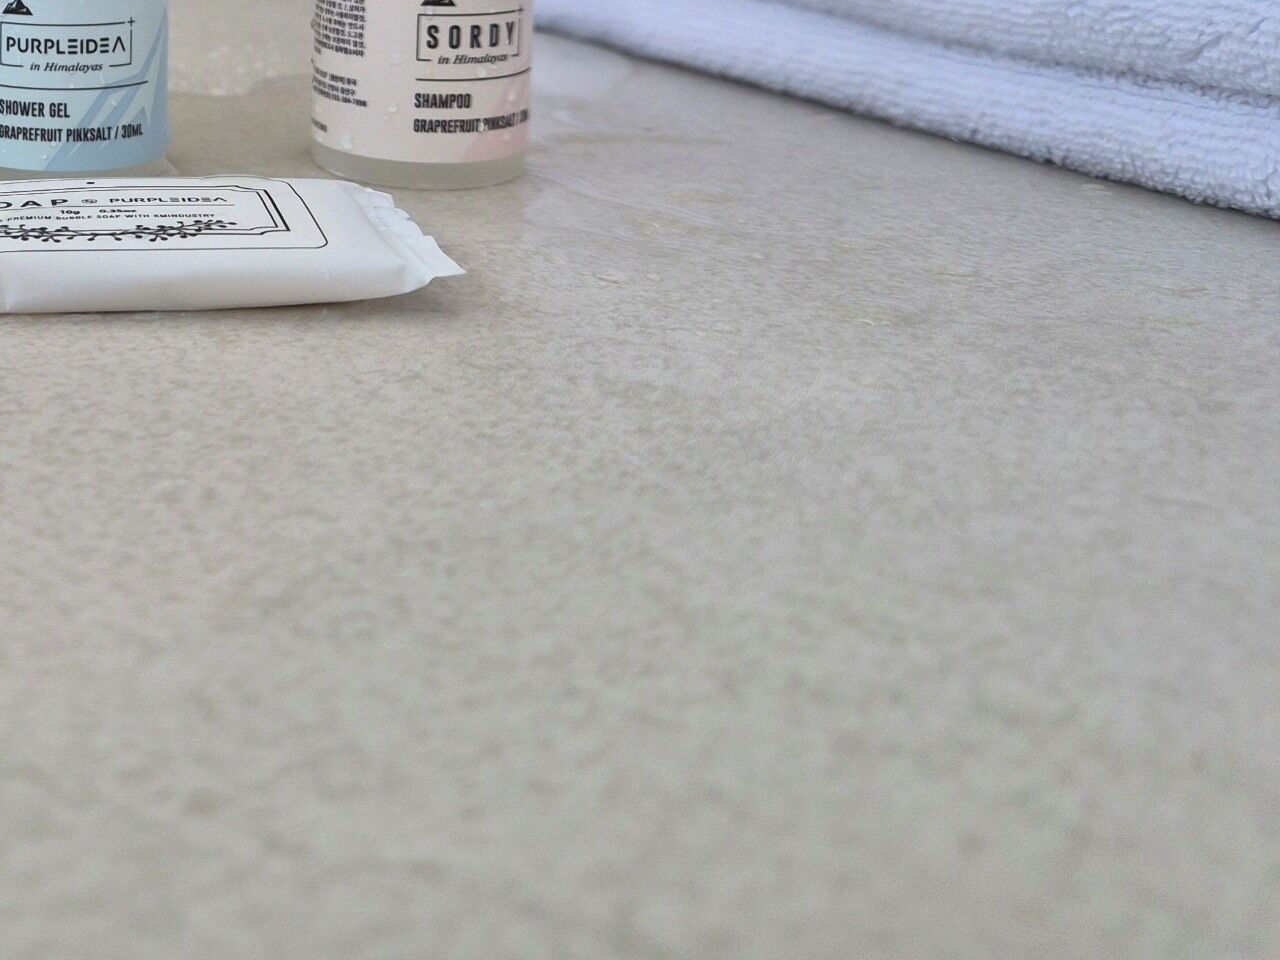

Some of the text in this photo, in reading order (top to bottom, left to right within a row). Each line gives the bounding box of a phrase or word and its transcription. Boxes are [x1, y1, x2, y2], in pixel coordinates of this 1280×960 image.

[426, 20, 516, 50] SORDY
[6, 36, 126, 55] PURPLEIDEA
[30, 61, 104, 74] in Himalayas
[437, 53, 509, 66] in Himalayas
[414, 93, 472, 109] SHAMPOO
[49, 102, 70, 119] GEL
[66, 126, 112, 143] PINKSALT
[121, 123, 144, 139] 30ML
[413, 118, 480, 134] GRAPREFRUIT
